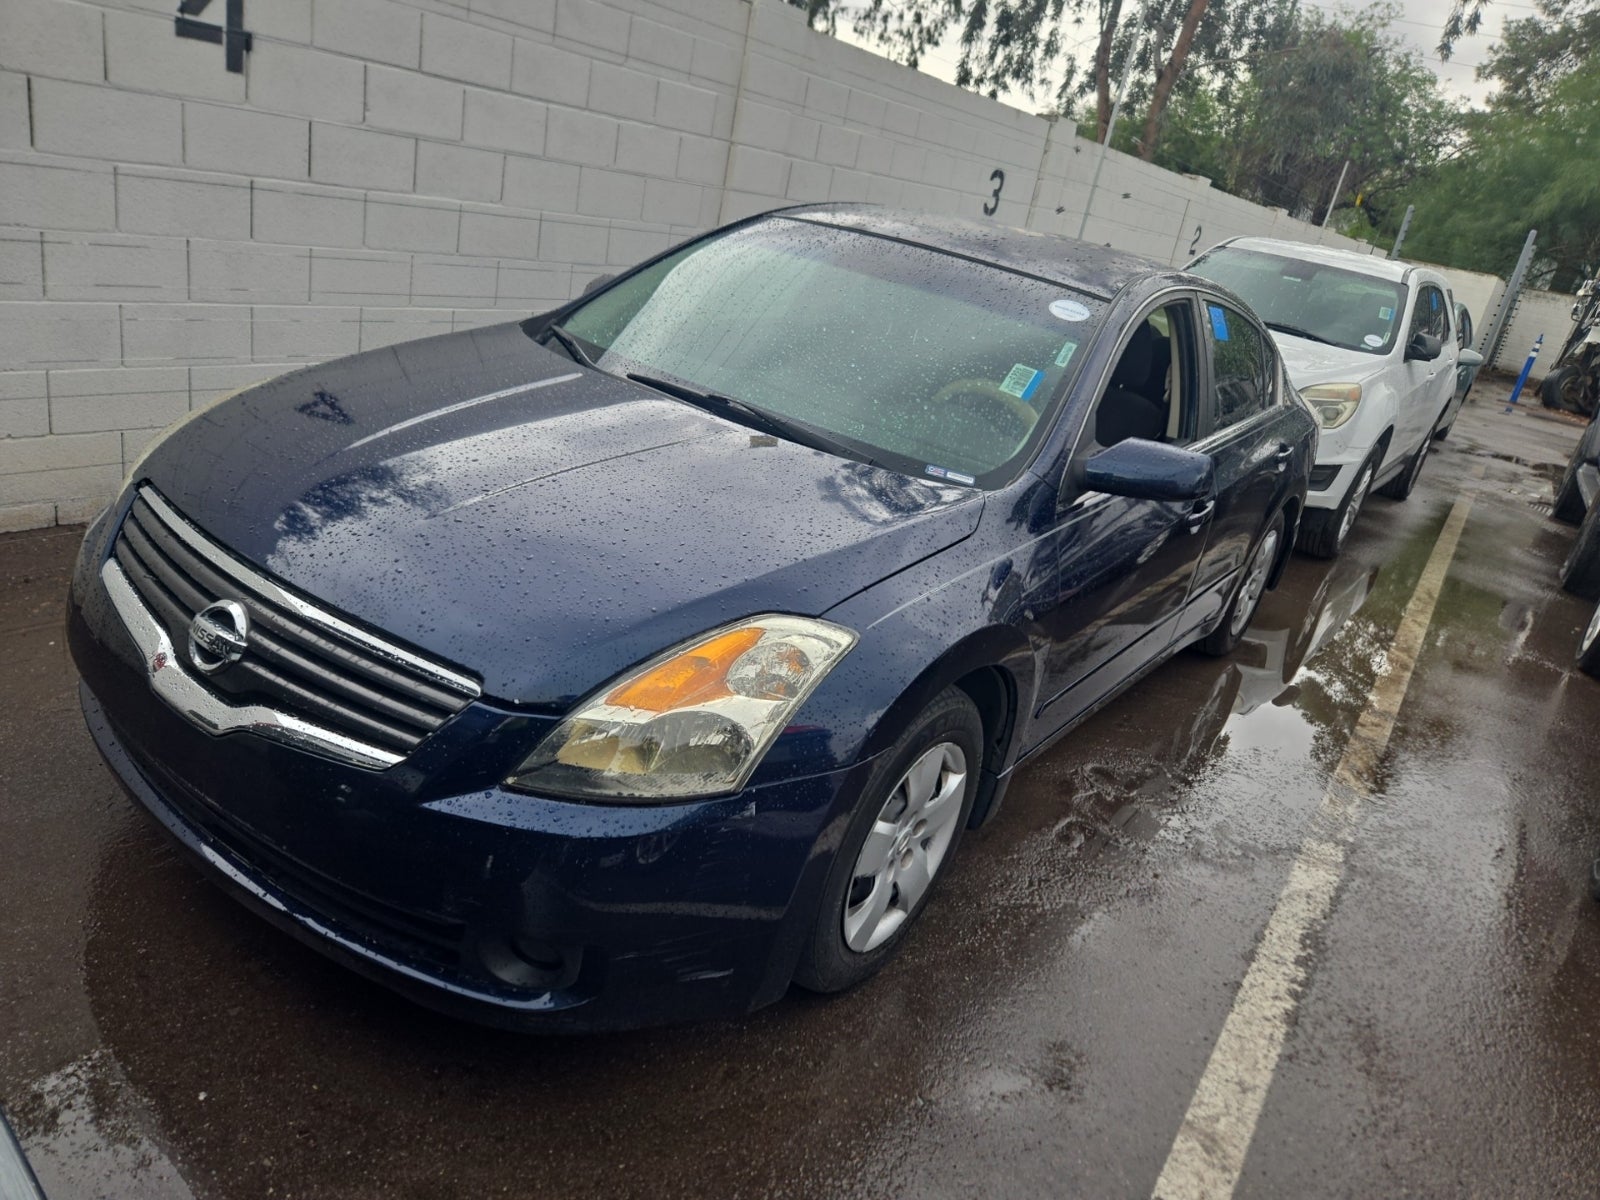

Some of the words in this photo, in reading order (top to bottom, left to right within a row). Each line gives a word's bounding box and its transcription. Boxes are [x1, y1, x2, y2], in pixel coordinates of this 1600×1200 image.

[175, 0, 252, 75] 4
[983, 169, 1005, 217] 3
[192, 620, 233, 656] NISSAN
